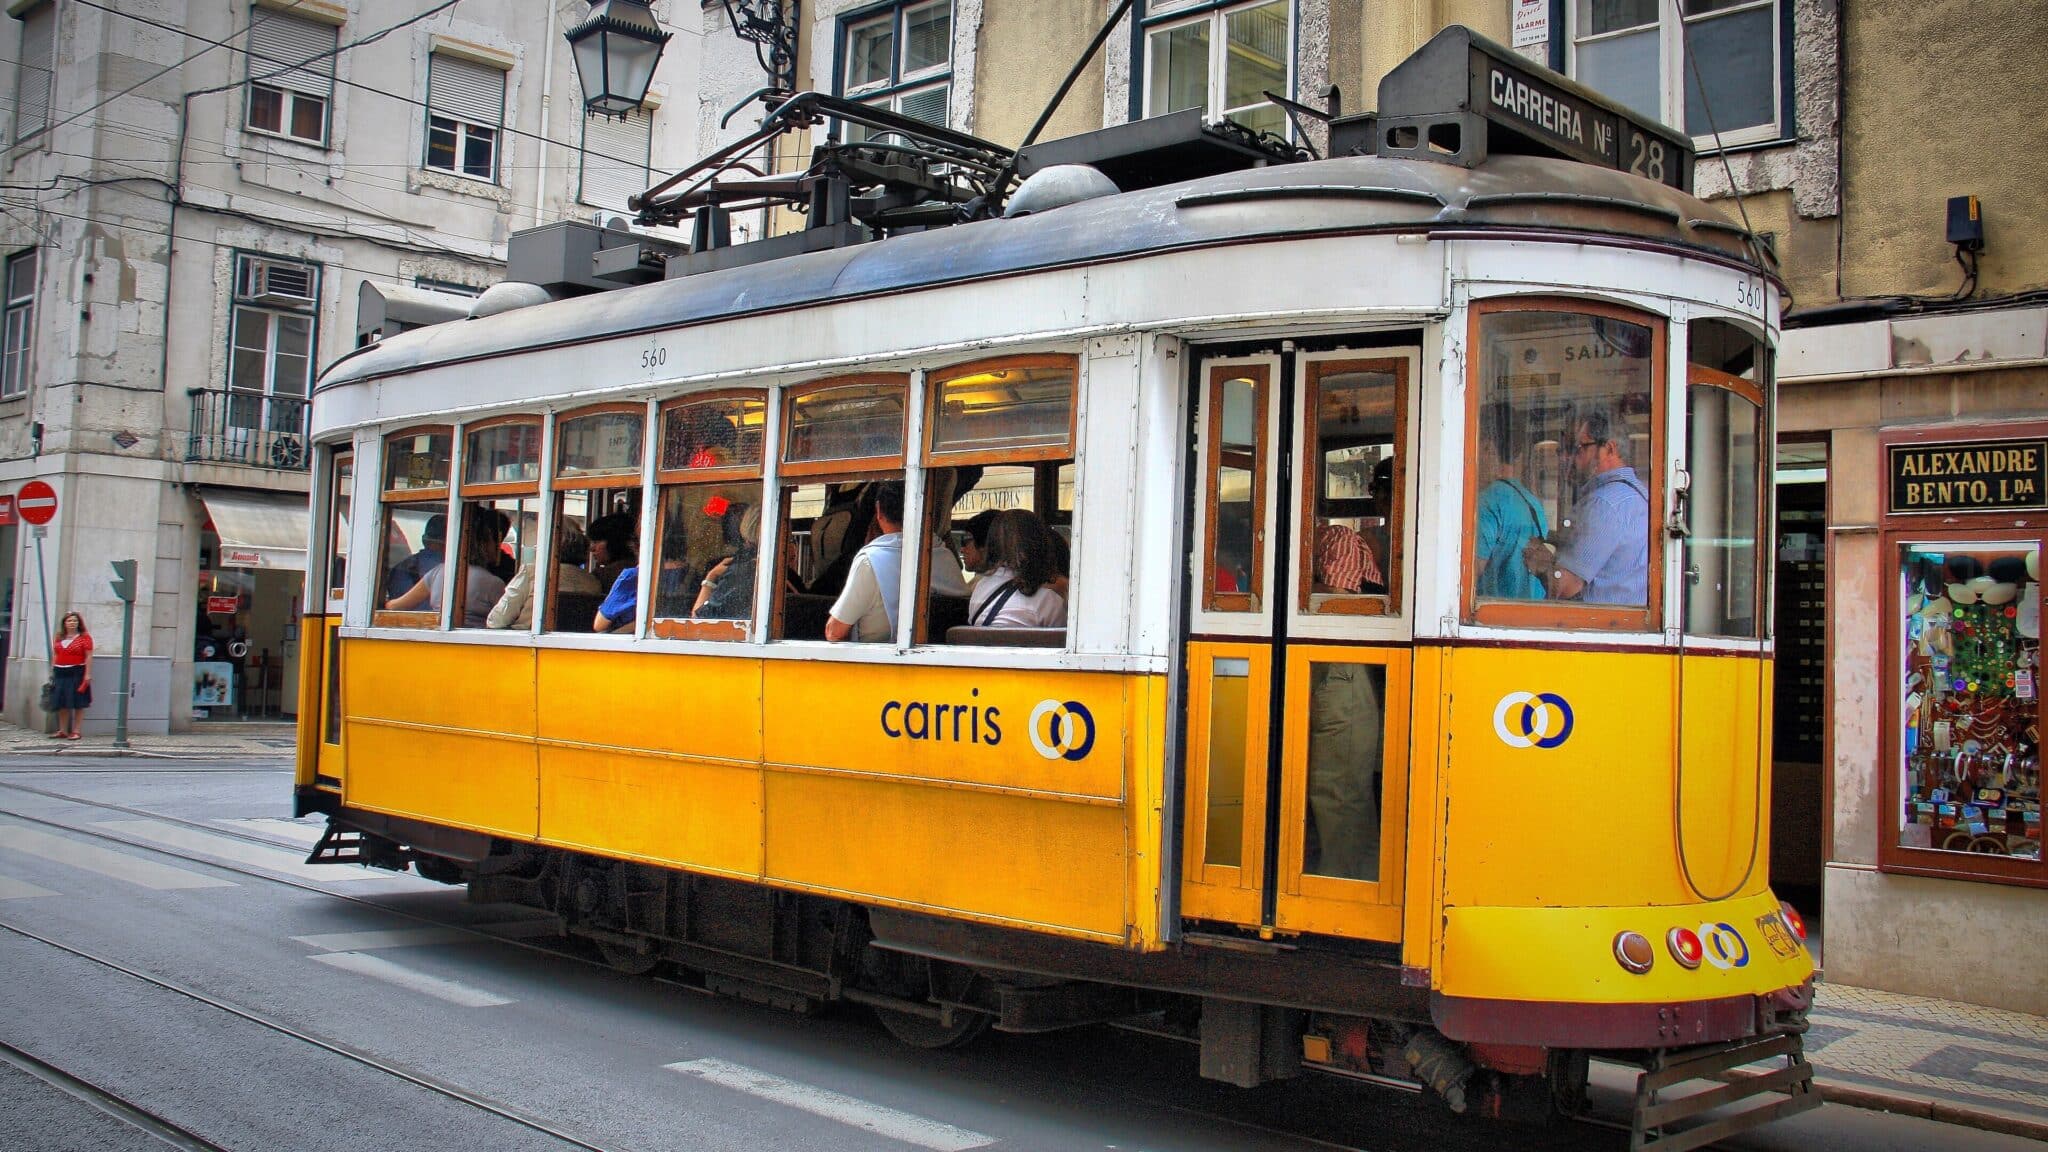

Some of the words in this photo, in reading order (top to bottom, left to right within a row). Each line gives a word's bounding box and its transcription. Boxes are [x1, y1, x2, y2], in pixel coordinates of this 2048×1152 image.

[1516, 18, 1547, 30] ALARME
[1490, 69, 1584, 145] CARREIRA
[1630, 132, 1664, 184] 28
[1737, 280, 1761, 310] 560
[641, 347, 667, 368] 560
[1565, 343, 1627, 361] SAID
[1901, 449, 2038, 476] ALEXANDRE
[880, 687, 1002, 746] carris
